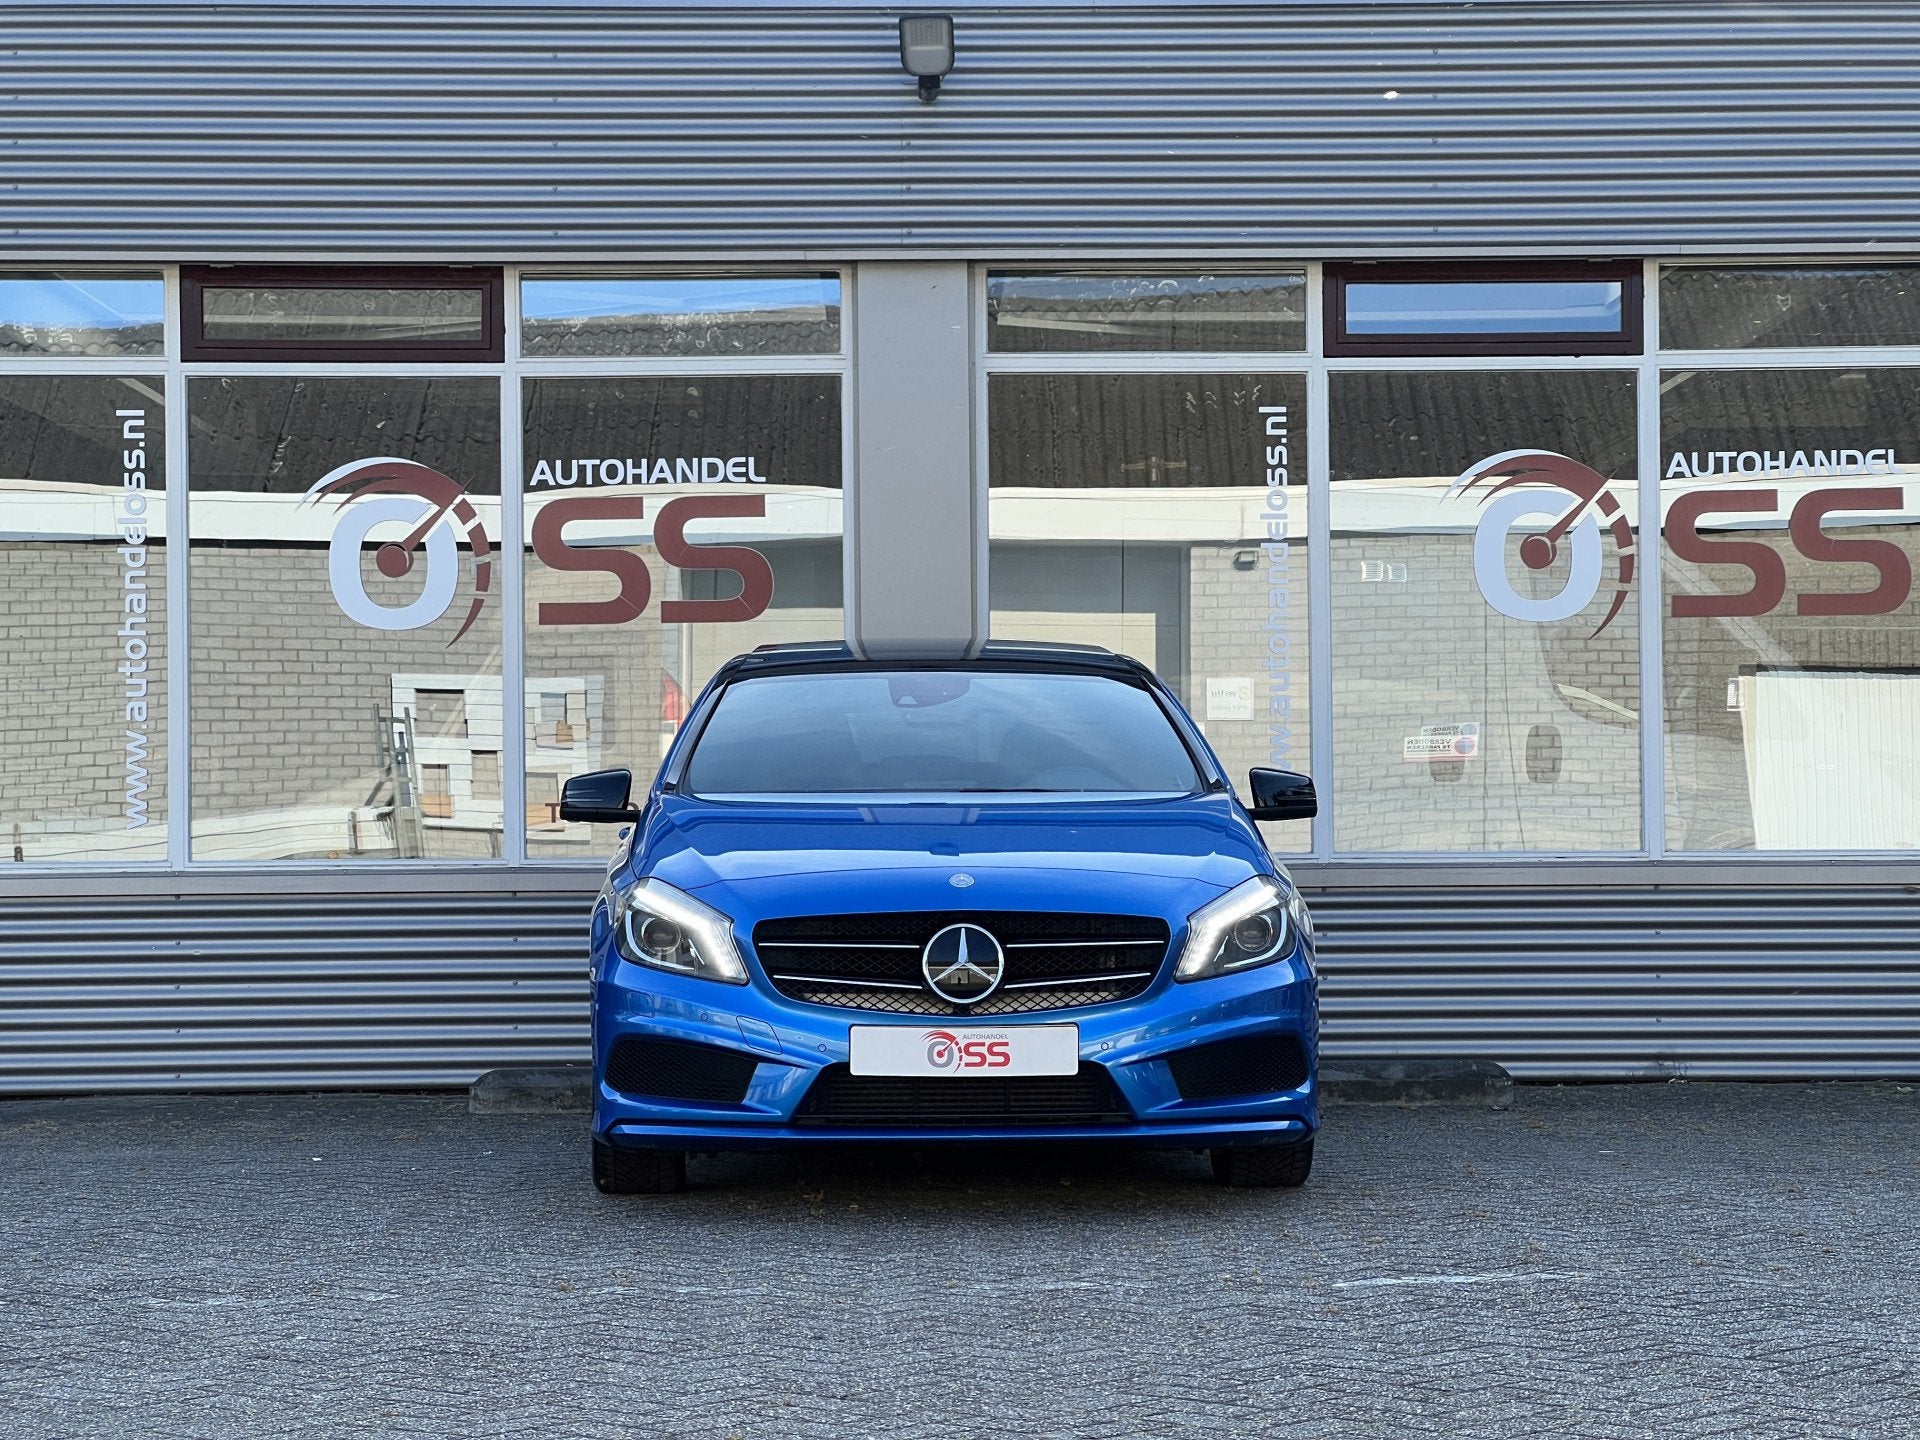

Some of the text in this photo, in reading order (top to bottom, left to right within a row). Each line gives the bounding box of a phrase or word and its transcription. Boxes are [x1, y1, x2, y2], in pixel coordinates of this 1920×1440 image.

[529, 456, 767, 486] AUTOHANDEL
[1666, 448, 1906, 479] AUTOHANDEL
[116, 409, 148, 830] www.autohandeloss.nl
[927, 1041, 1011, 1069] OSS
